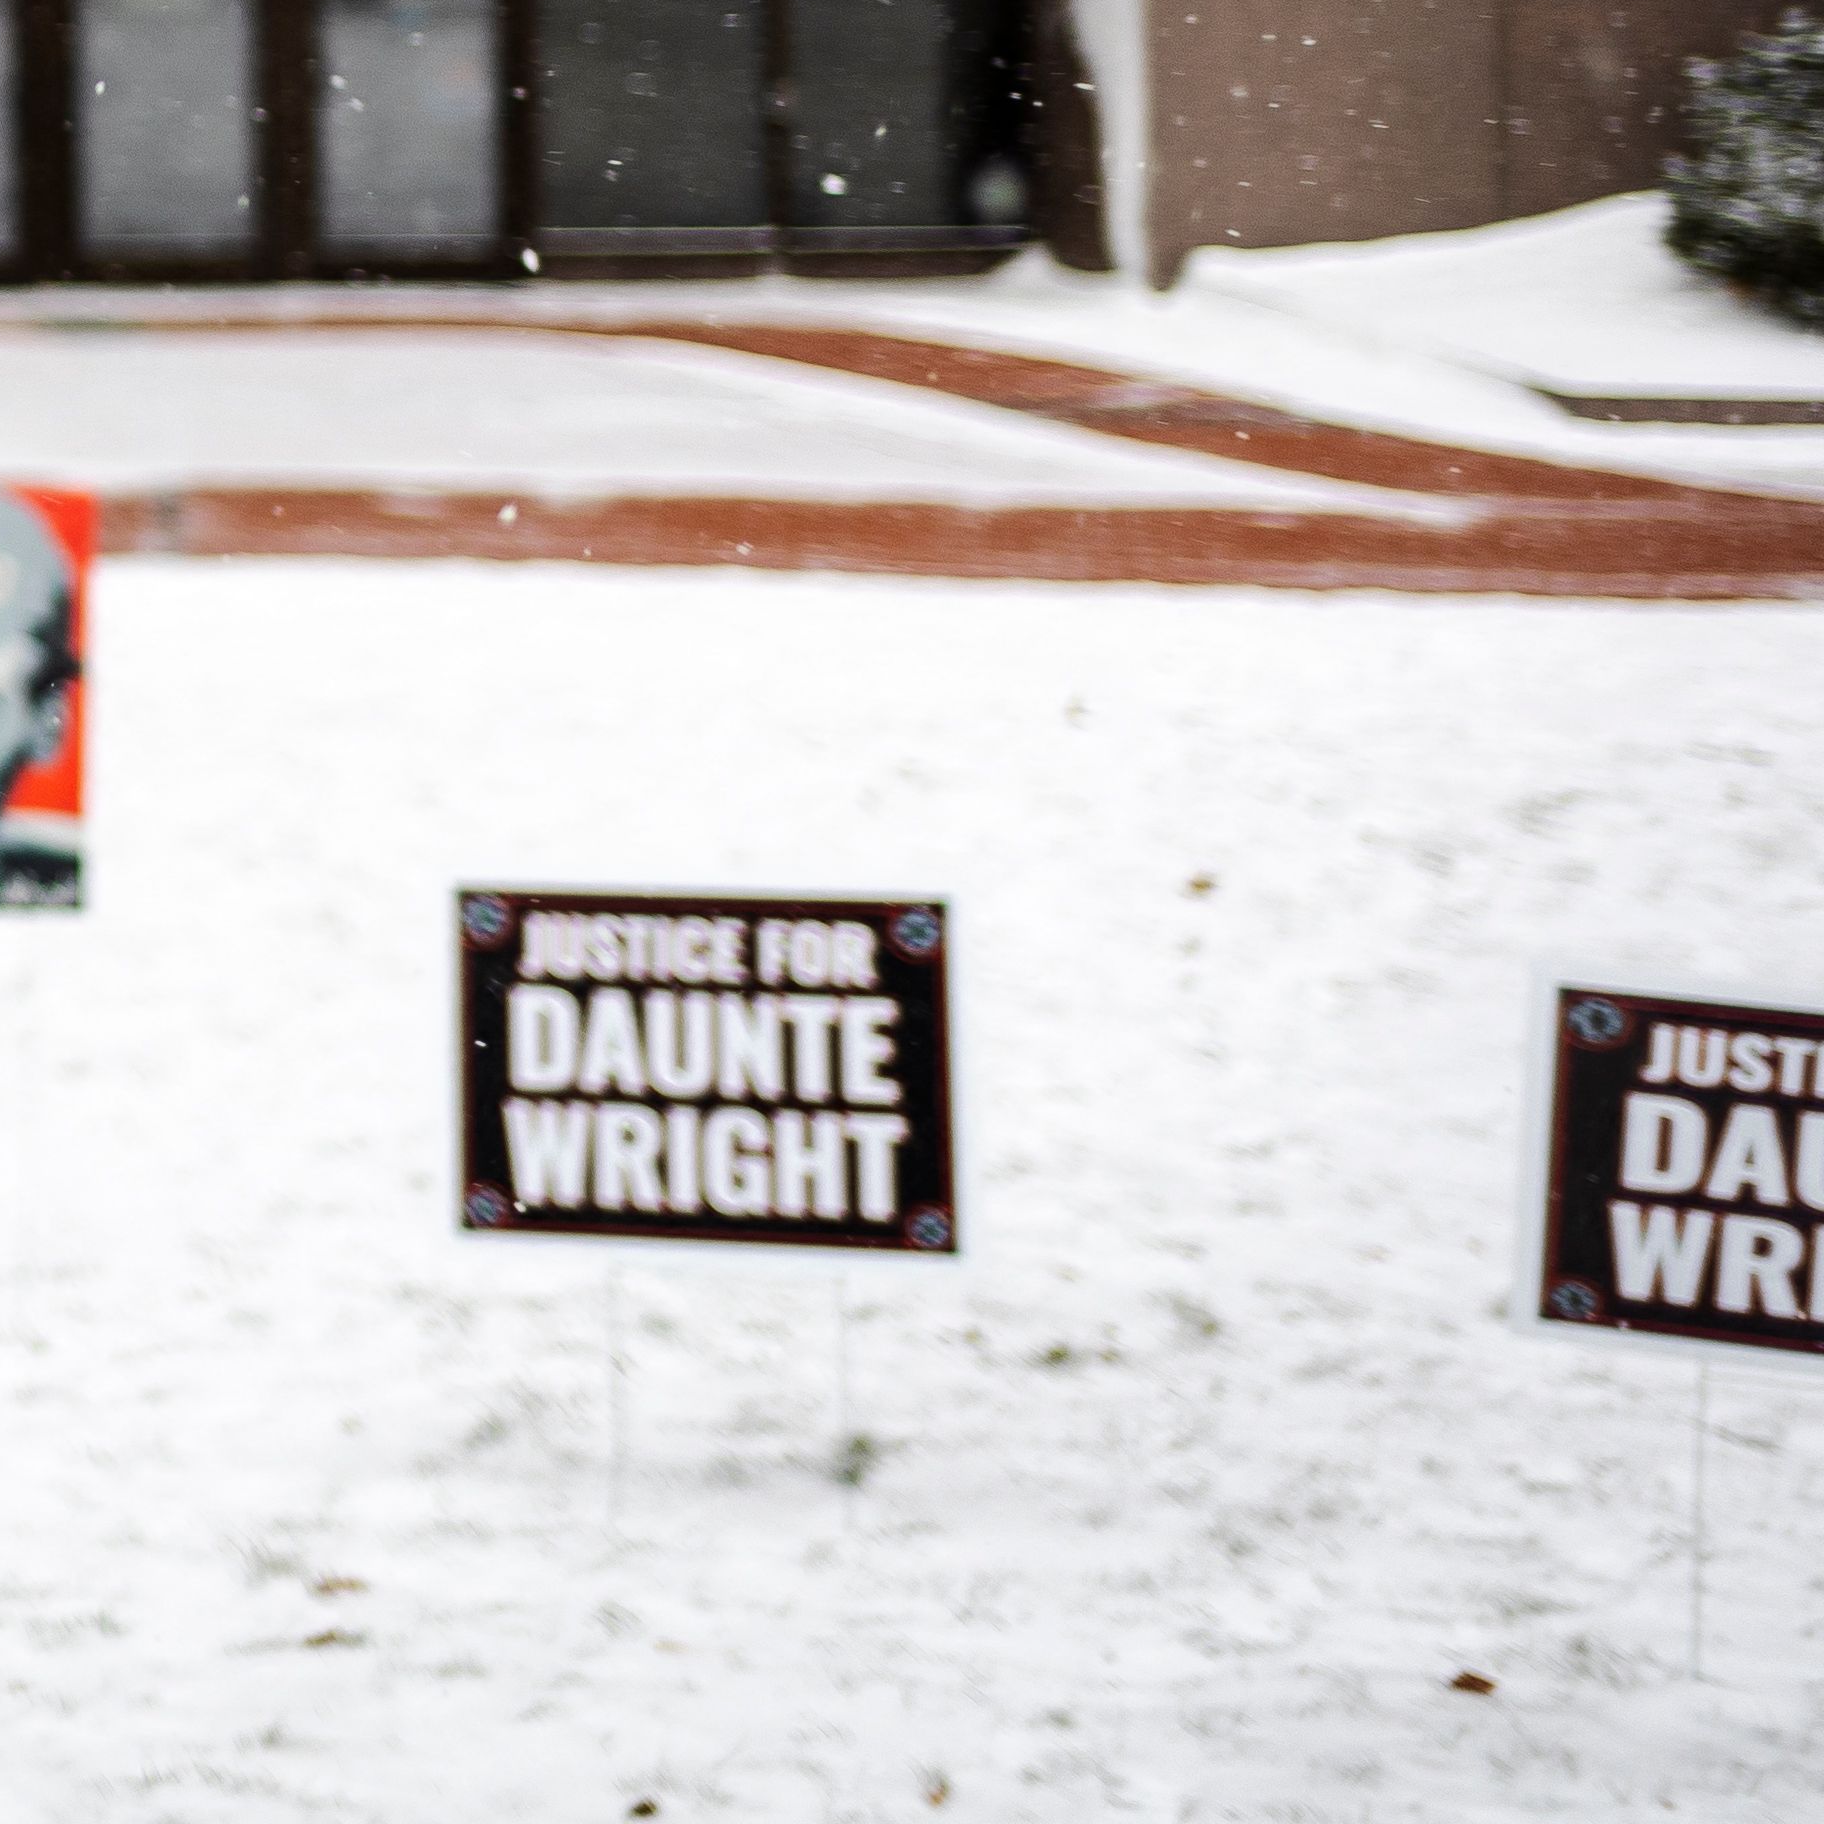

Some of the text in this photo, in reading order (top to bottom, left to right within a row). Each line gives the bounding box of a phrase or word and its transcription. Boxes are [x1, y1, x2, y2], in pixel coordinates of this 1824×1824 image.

[517, 910, 878, 989] JUSTICE FOR
[506, 982, 901, 1106] DAUNTE
[500, 1096, 910, 1224] WRIGHT
